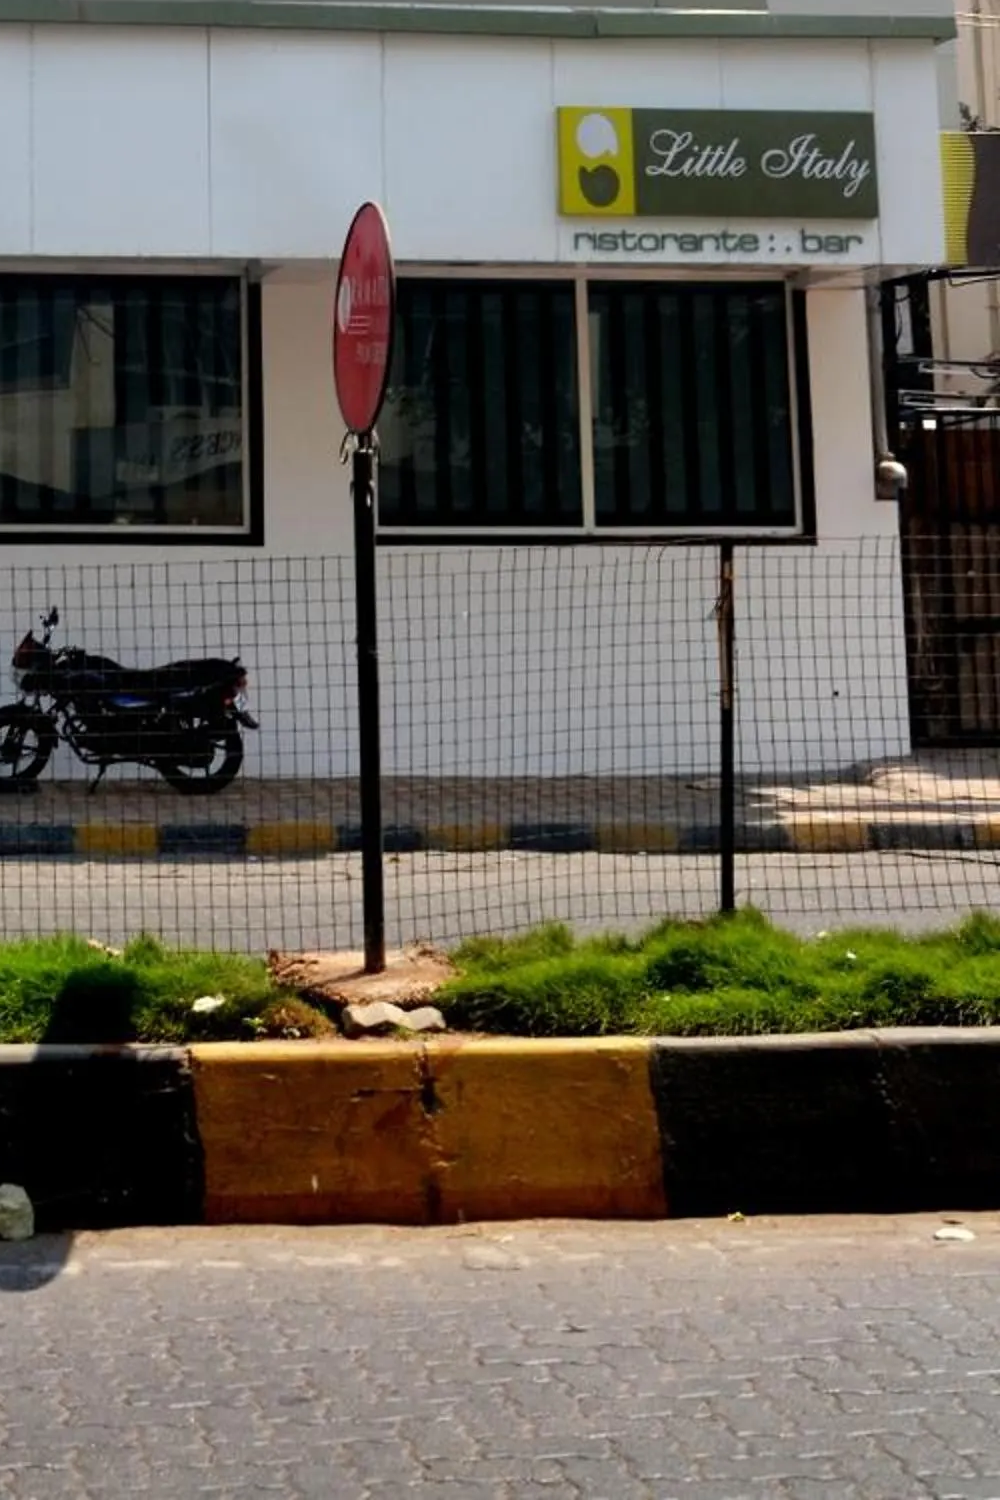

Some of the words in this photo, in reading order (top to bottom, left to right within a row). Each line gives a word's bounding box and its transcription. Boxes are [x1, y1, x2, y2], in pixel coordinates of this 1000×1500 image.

[645, 129, 748, 178] Little
[761, 133, 871, 199] Italy
[573, 230, 760, 253] ristorante
[801, 228, 863, 255] bar
